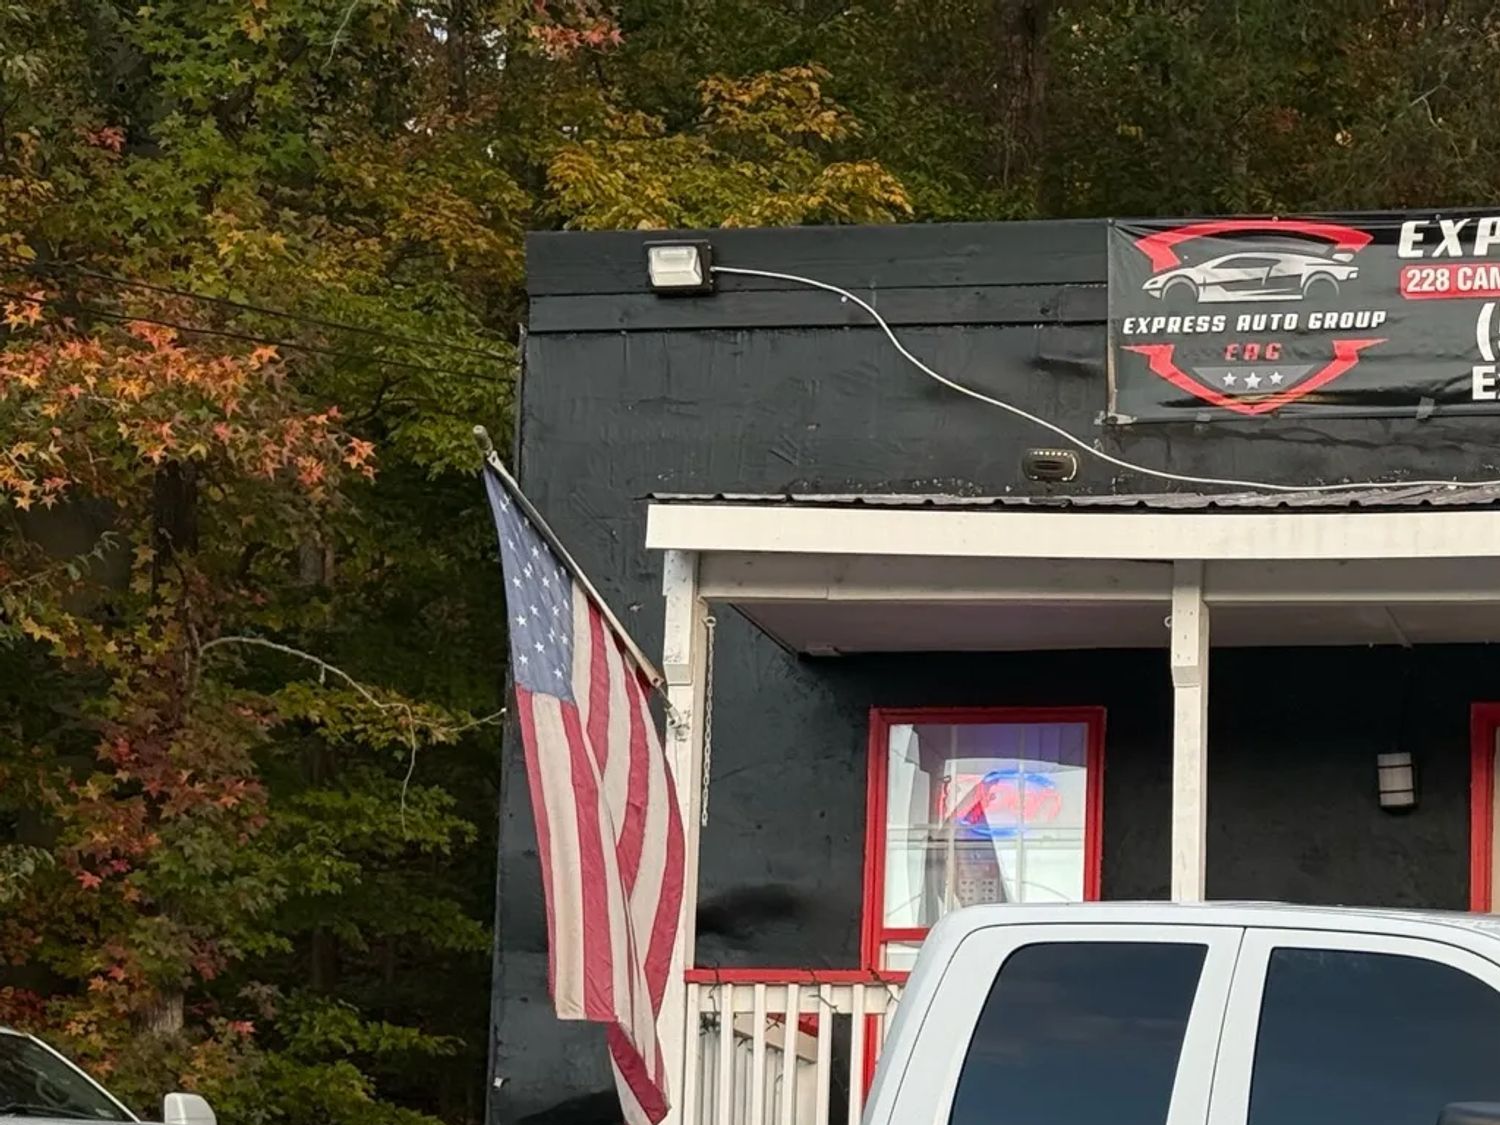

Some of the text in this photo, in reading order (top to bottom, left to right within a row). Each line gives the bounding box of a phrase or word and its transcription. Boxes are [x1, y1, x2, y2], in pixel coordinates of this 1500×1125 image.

[1406, 265, 1450, 292] 228
[1122, 310, 1388, 335] EXPRESS AUTO GROUP
